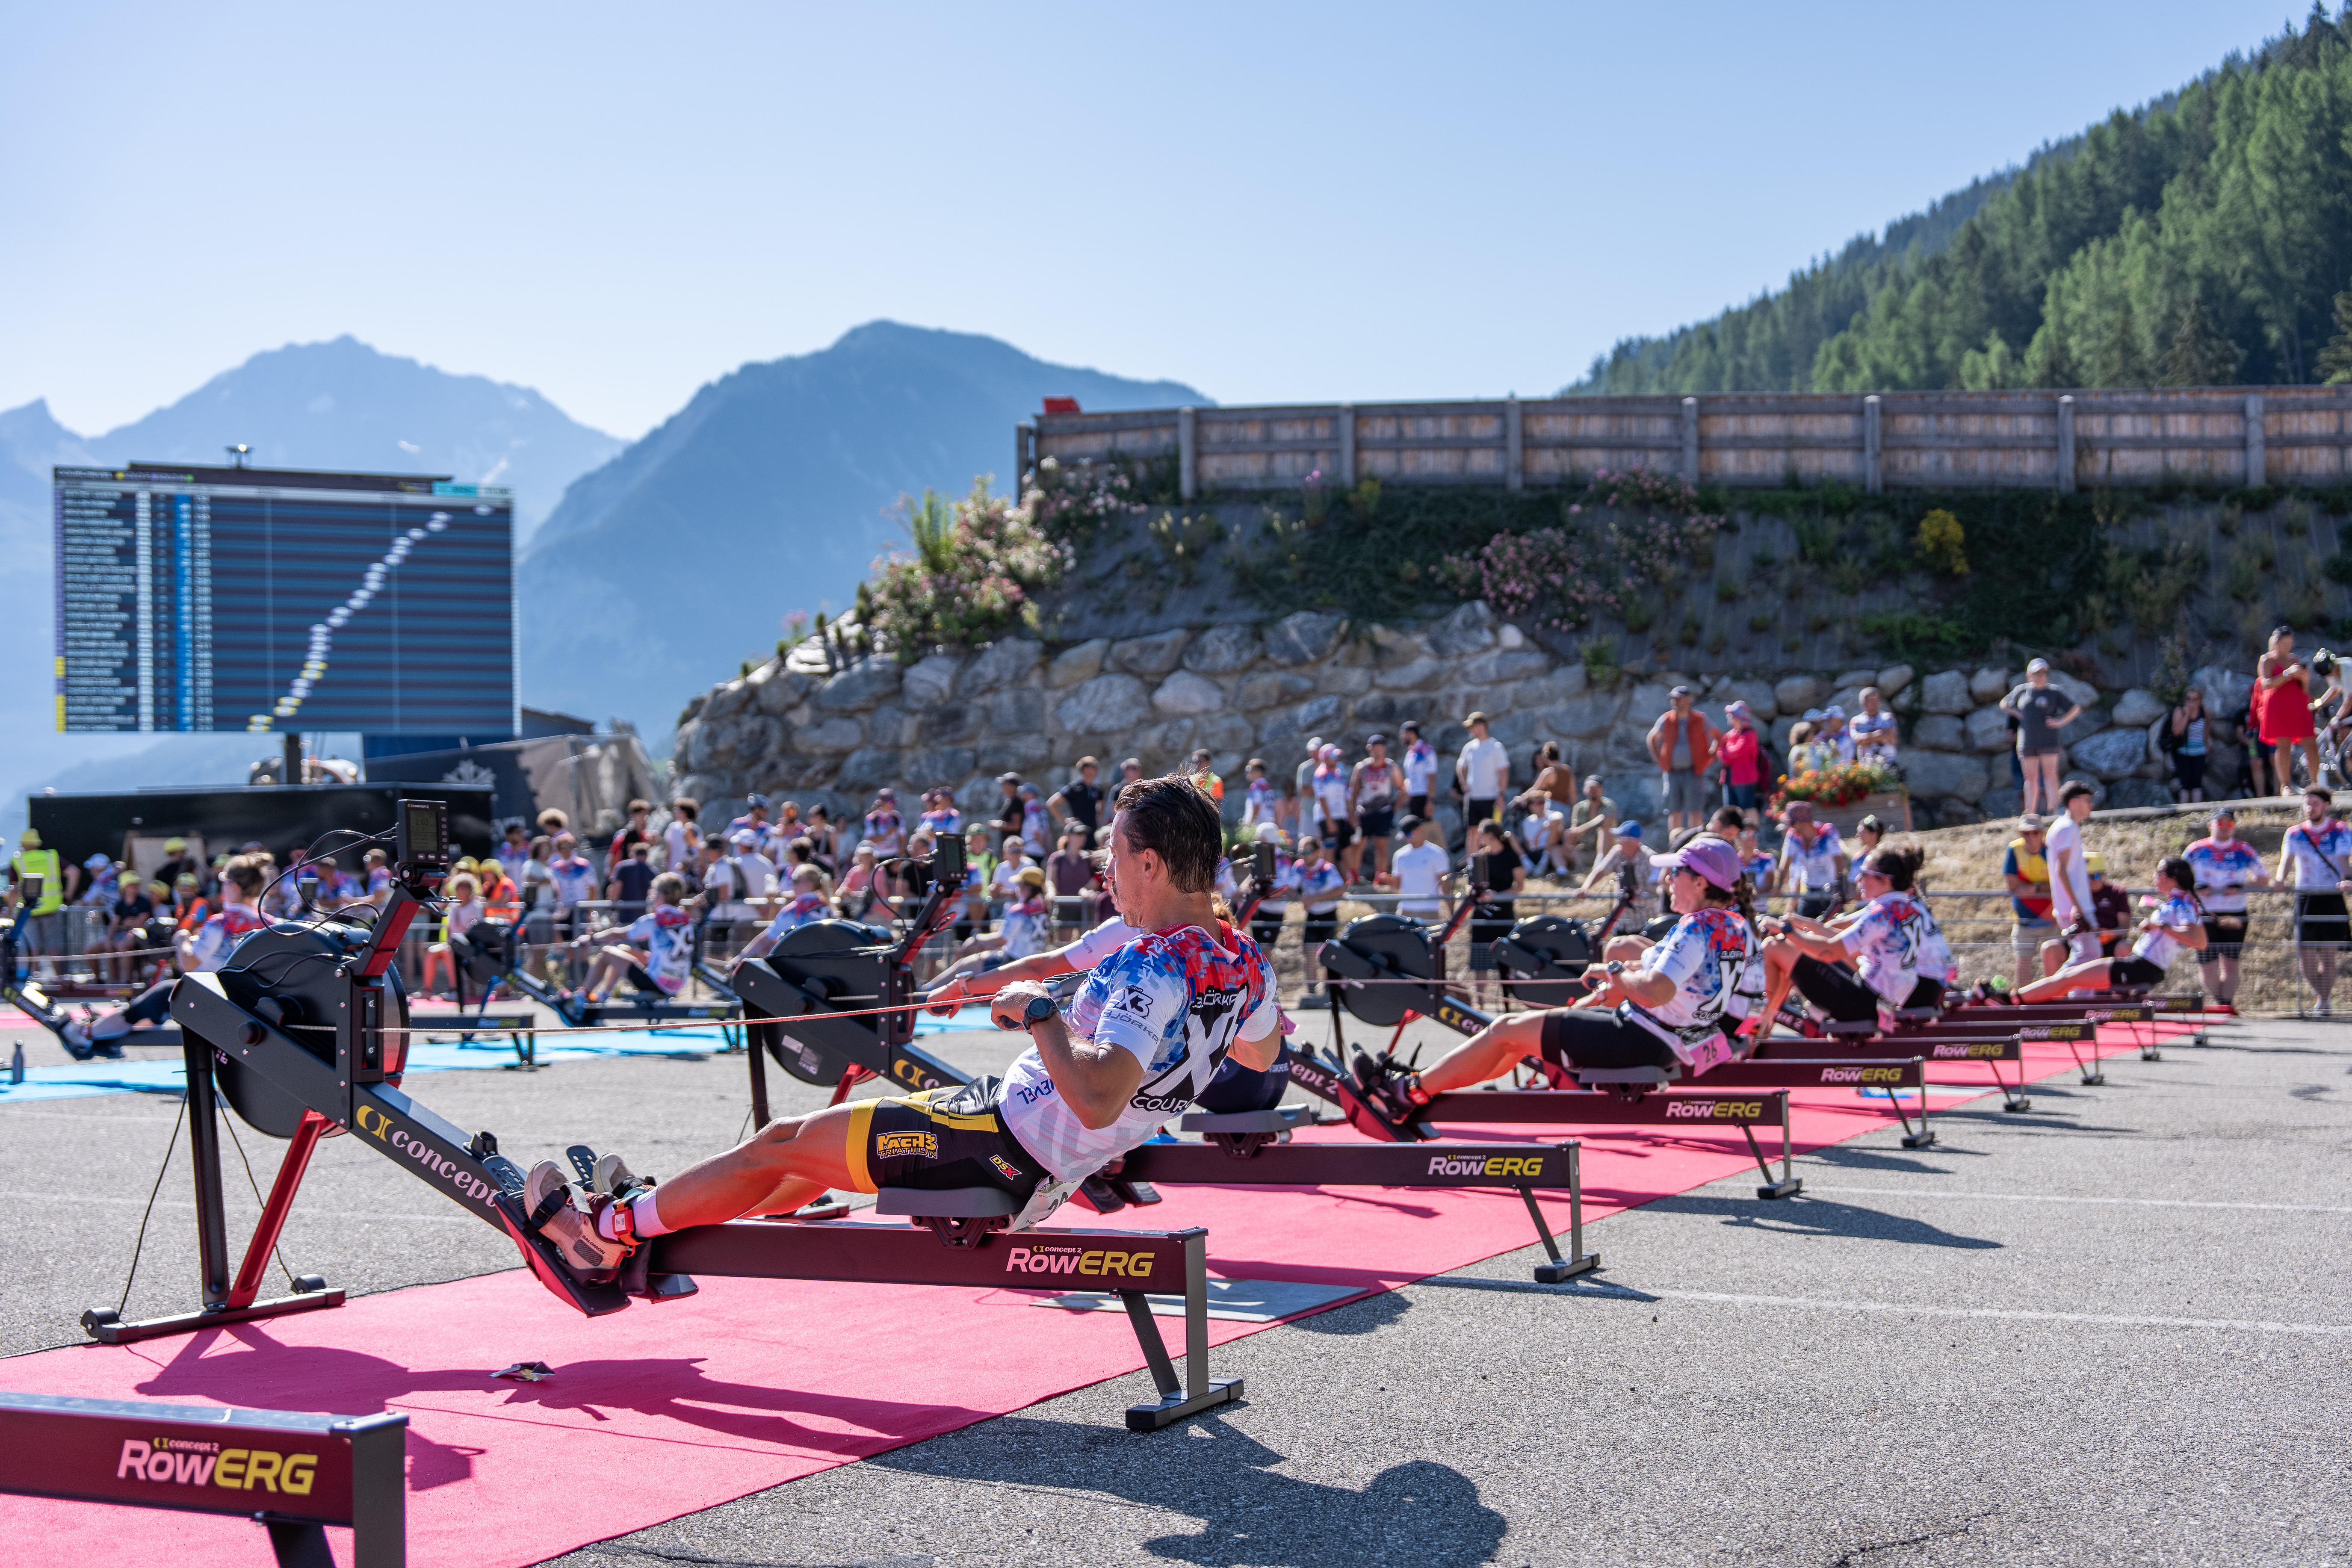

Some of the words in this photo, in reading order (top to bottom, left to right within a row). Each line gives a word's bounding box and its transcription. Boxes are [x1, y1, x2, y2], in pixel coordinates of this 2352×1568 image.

[1114, 989, 1153, 1018] X3
[1703, 1040, 1717, 1063] 26
[991, 1156, 1019, 1178] DSX
[582, 1234, 606, 1255] SALOMON
[169, 1439, 212, 1452] concept
